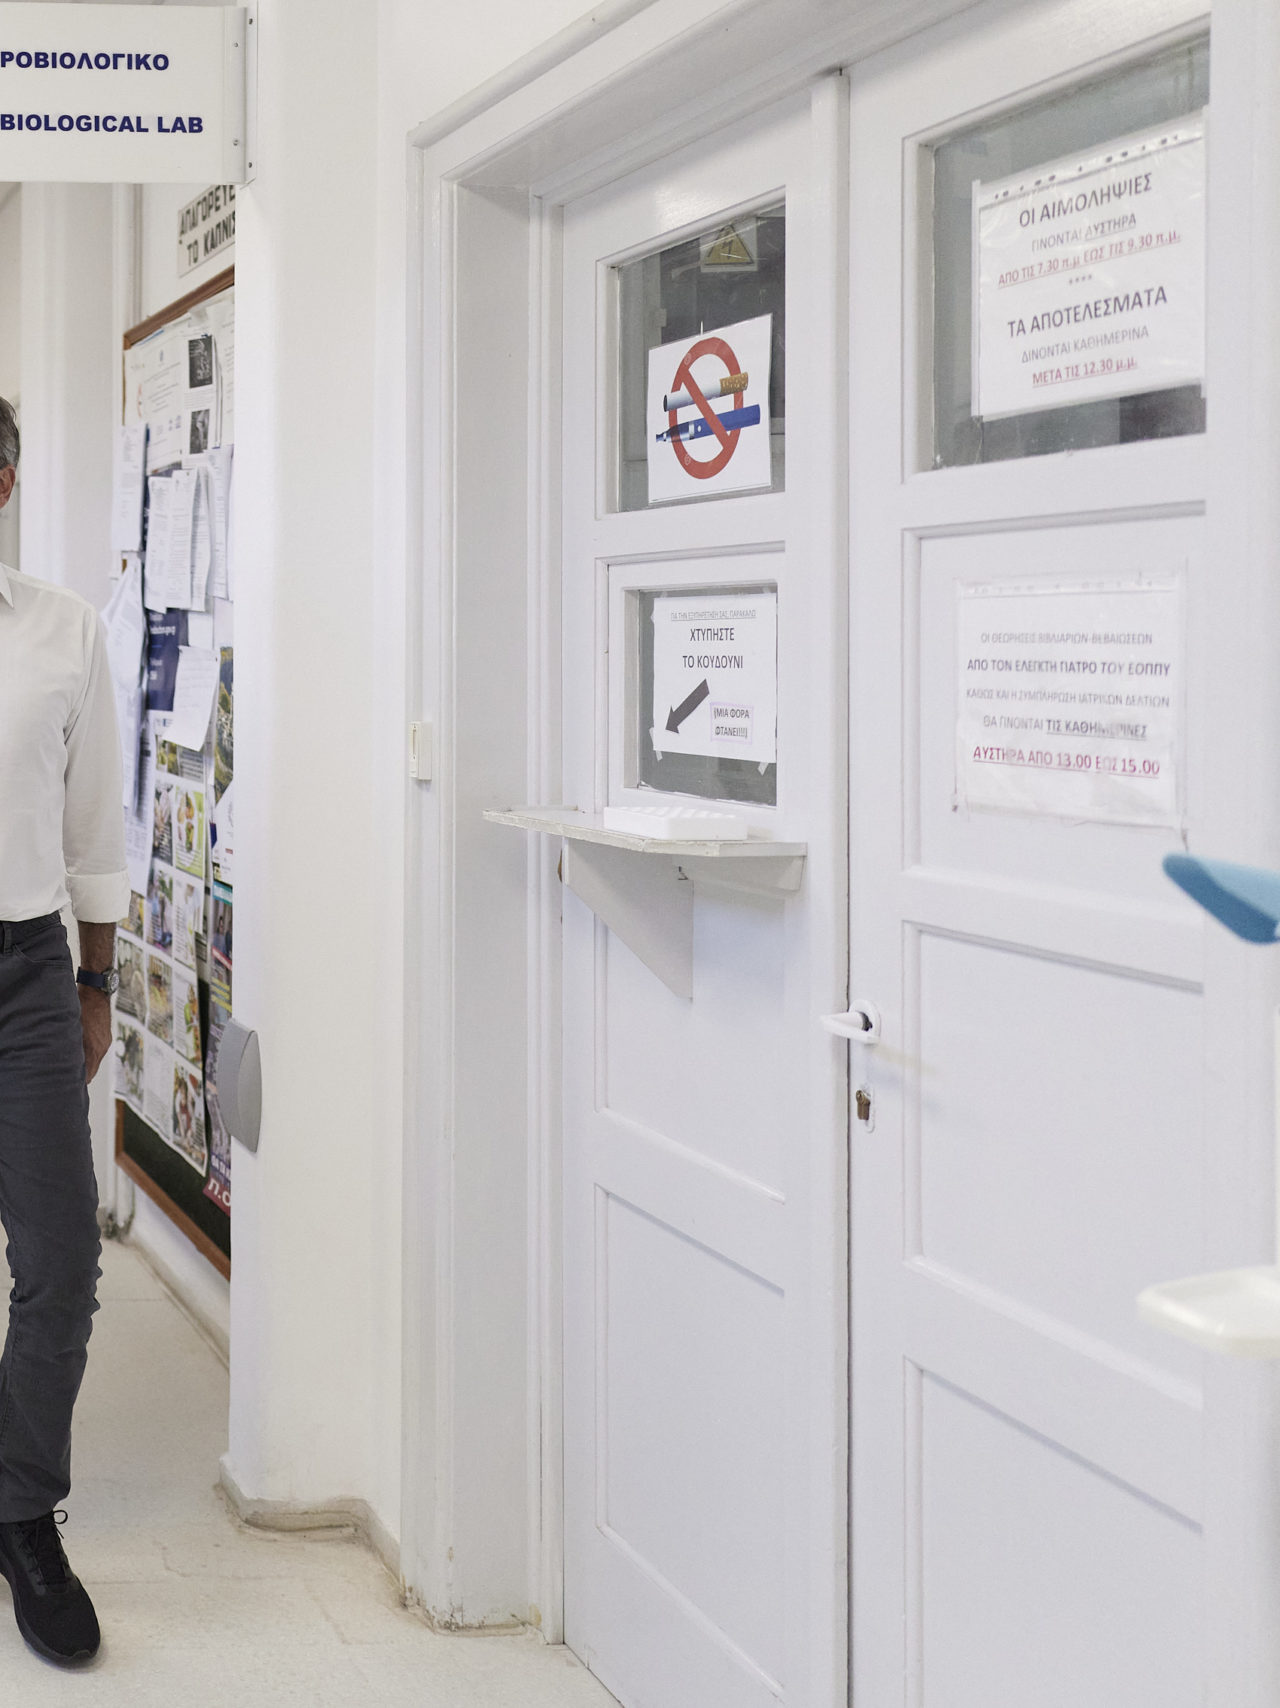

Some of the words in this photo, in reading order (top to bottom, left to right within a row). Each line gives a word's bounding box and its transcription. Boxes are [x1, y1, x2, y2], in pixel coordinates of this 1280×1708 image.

[157, 115, 204, 133] LAB
[1019, 208, 1035, 228] ΟΙ
[1039, 172, 1152, 222] ΑΙΜΟΛΗΨΙΕΣ
[187, 240, 199, 266] ΤΟ
[998, 269, 1019, 285] ΑΠΟ
[1022, 265, 1035, 279] ΤΙΣ
[1037, 258, 1059, 275] 7.30
[1083, 248, 1104, 264] ΕΩΣ
[1109, 241, 1125, 257] ΤΙΣ
[1128, 233, 1153, 250] 9.30
[1008, 319, 1026, 339] ΤΑ
[1030, 285, 1168, 333] ΑΠΟΤΕΛΕΣΜΑΤΑ
[1021, 342, 1071, 364] ΔΙΝΟΝΤΑΙ
[1073, 325, 1149, 353] ΚΑΘΗΜΕΡΙΝΑ
[1032, 369, 1063, 385] ΜΕΤΑ
[1065, 365, 1081, 379] ΤΙΣ
[1083, 357, 1113, 376] 12.30
[690, 627, 735, 642] ΧΤΥΠΗΣΤΕ
[682, 655, 695, 669] ΤΟ
[697, 655, 743, 669] ΚΟΥΔΟΥΝΙ
[967, 658, 988, 671] ΑΠΟ
[991, 659, 1013, 672] ΤΟΝ
[1015, 659, 1057, 672] ΕΛΕΓΚΤΗ
[1060, 660, 1097, 674] ΓΙΑΤΡΟ
[1101, 662, 1124, 674] ΤΟΥ
[1128, 662, 1170, 676] ΕΟΠΠΥ
[730, 708, 750, 719] ΦΟΡΑ
[983, 715, 997, 728] ΘΑ
[1046, 719, 1062, 732] ΤΙΣ
[973, 746, 1025, 762] ΑΥΣΤΗΡΑ
[1028, 750, 1053, 766] ΑΠΟ
[1057, 752, 1092, 769] 13.00
[1121, 758, 1160, 775] 15.00
